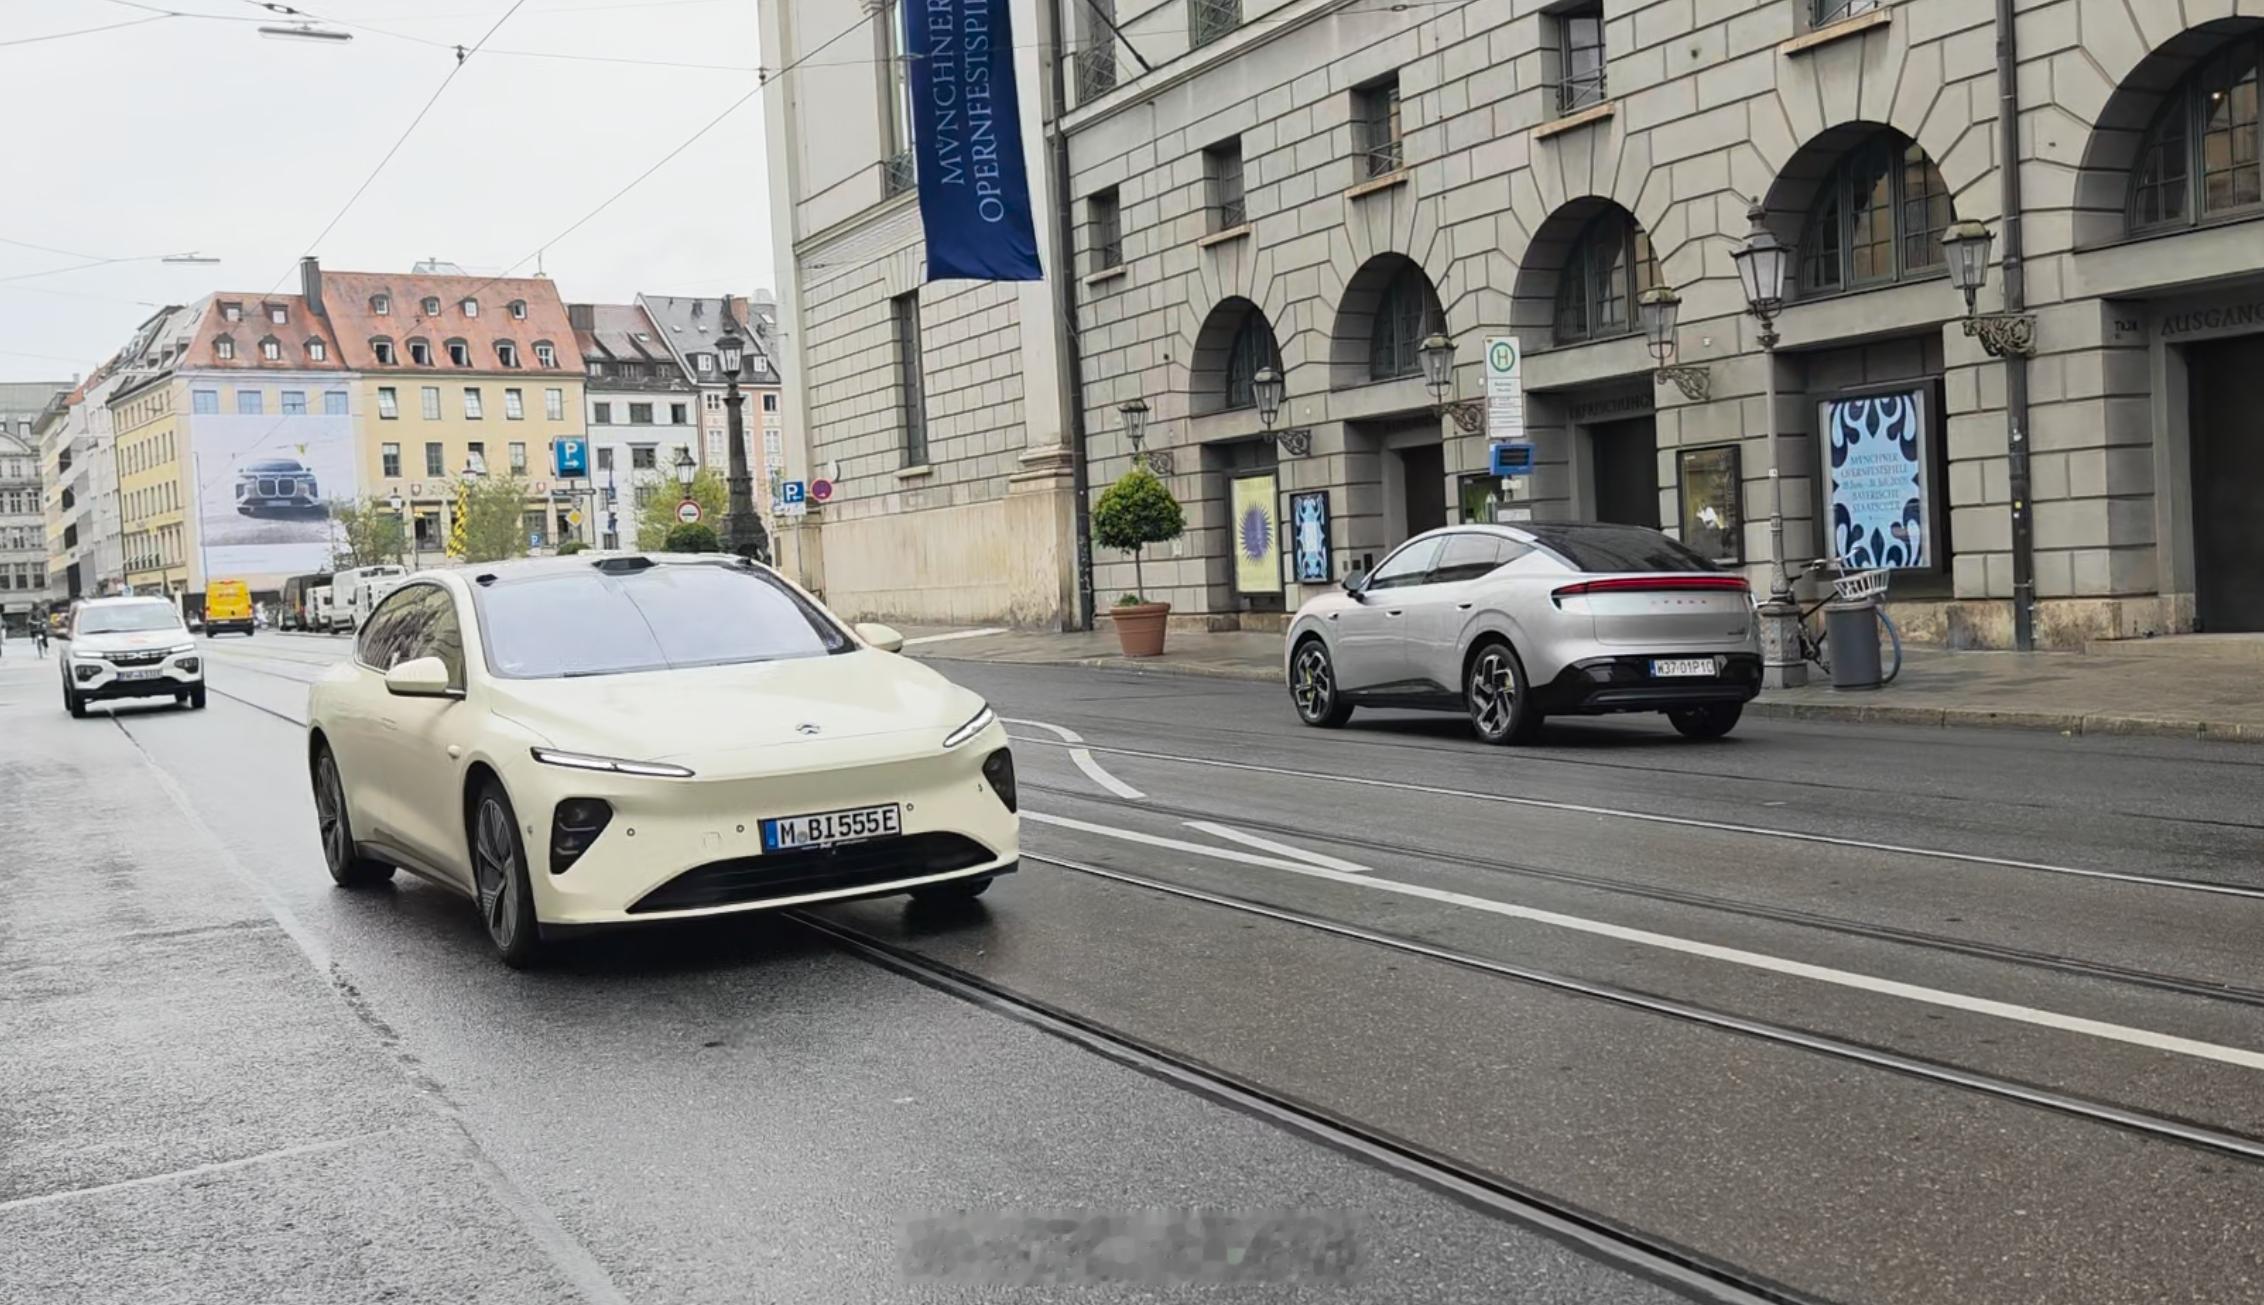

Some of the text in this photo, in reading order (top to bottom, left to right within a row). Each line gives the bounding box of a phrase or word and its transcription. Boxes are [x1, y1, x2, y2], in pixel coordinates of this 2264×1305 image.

[963, 0, 1005, 223] OPERNFESTSPI
[1496, 348, 1509, 366] H
[565, 442, 578, 460] P
[785, 484, 798, 502] P
[808, 808, 897, 842] BI555E
